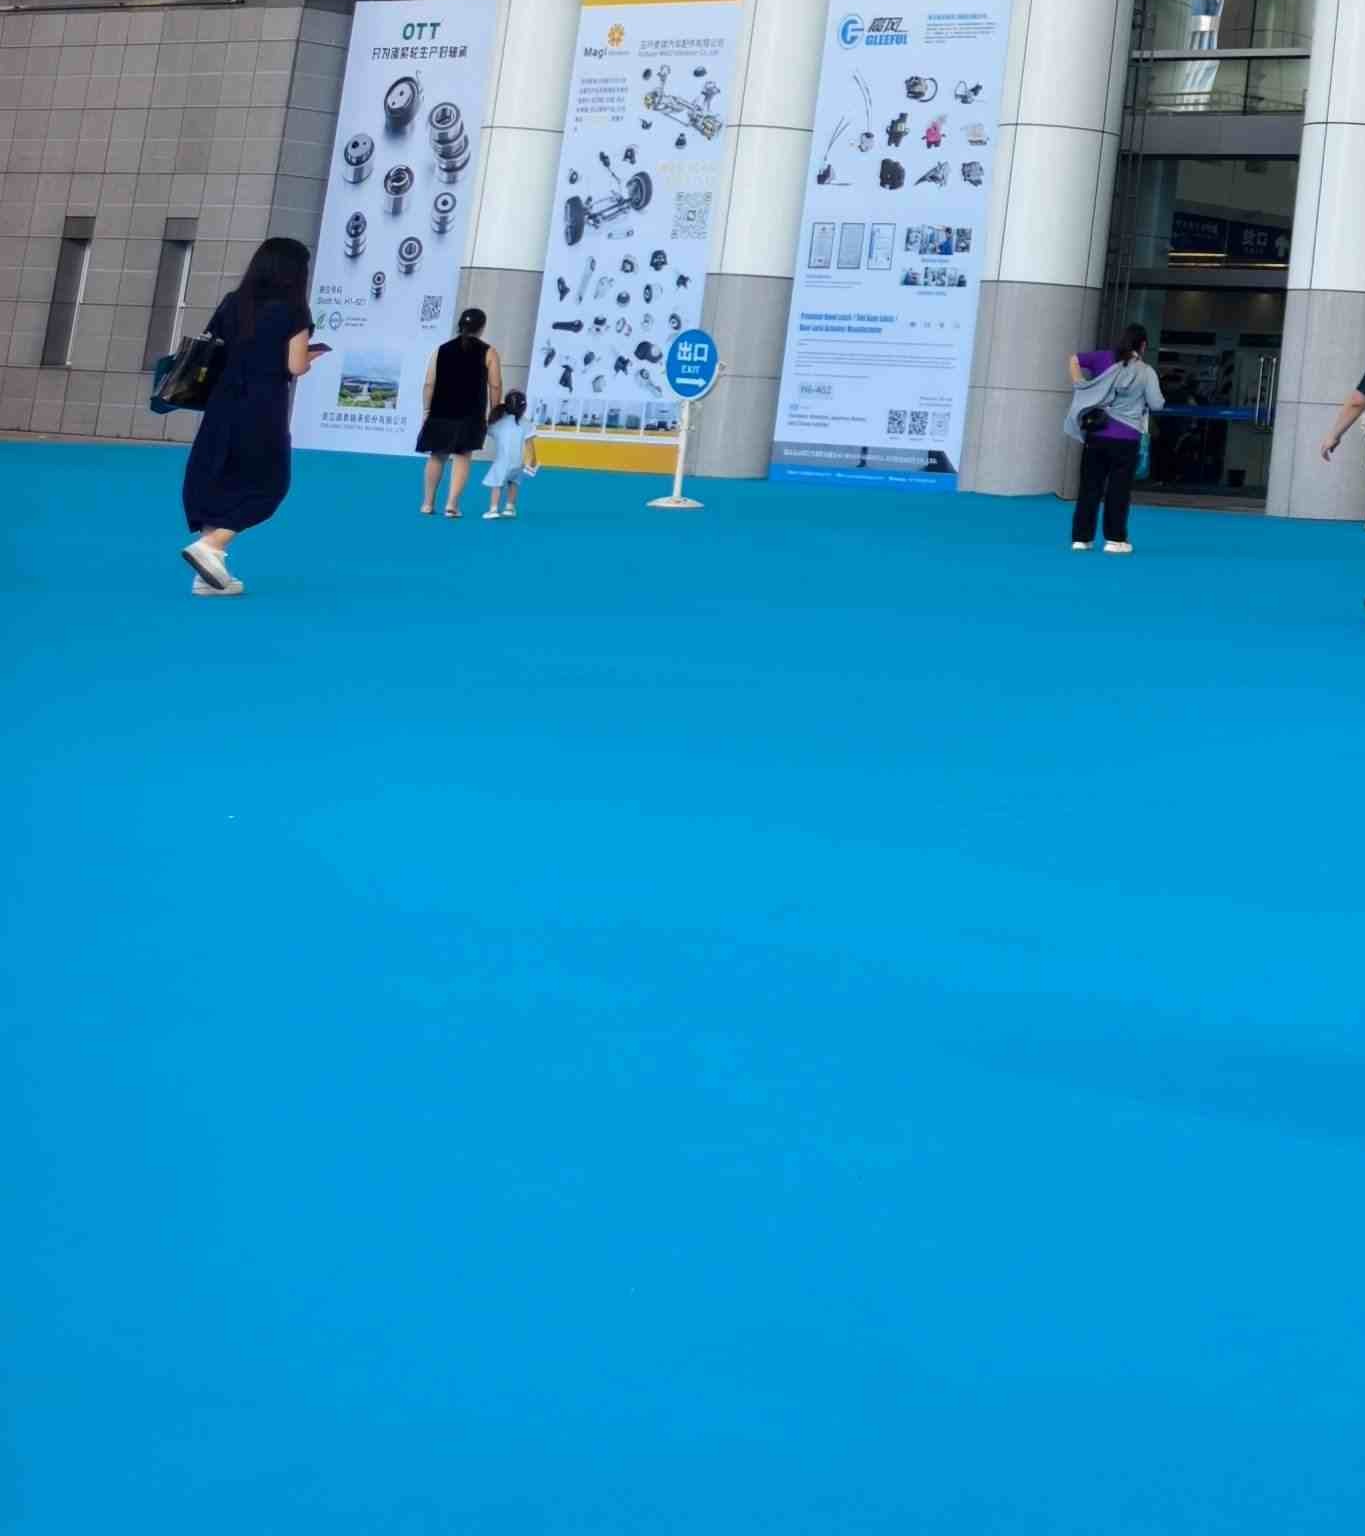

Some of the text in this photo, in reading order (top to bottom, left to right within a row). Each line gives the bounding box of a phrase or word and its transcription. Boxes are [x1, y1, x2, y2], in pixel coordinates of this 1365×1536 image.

[402, 22, 441, 41] OTT
[864, 34, 909, 46] GLEEFUL
[676, 340, 709, 363] 出口
[681, 364, 700, 375] EXIT
